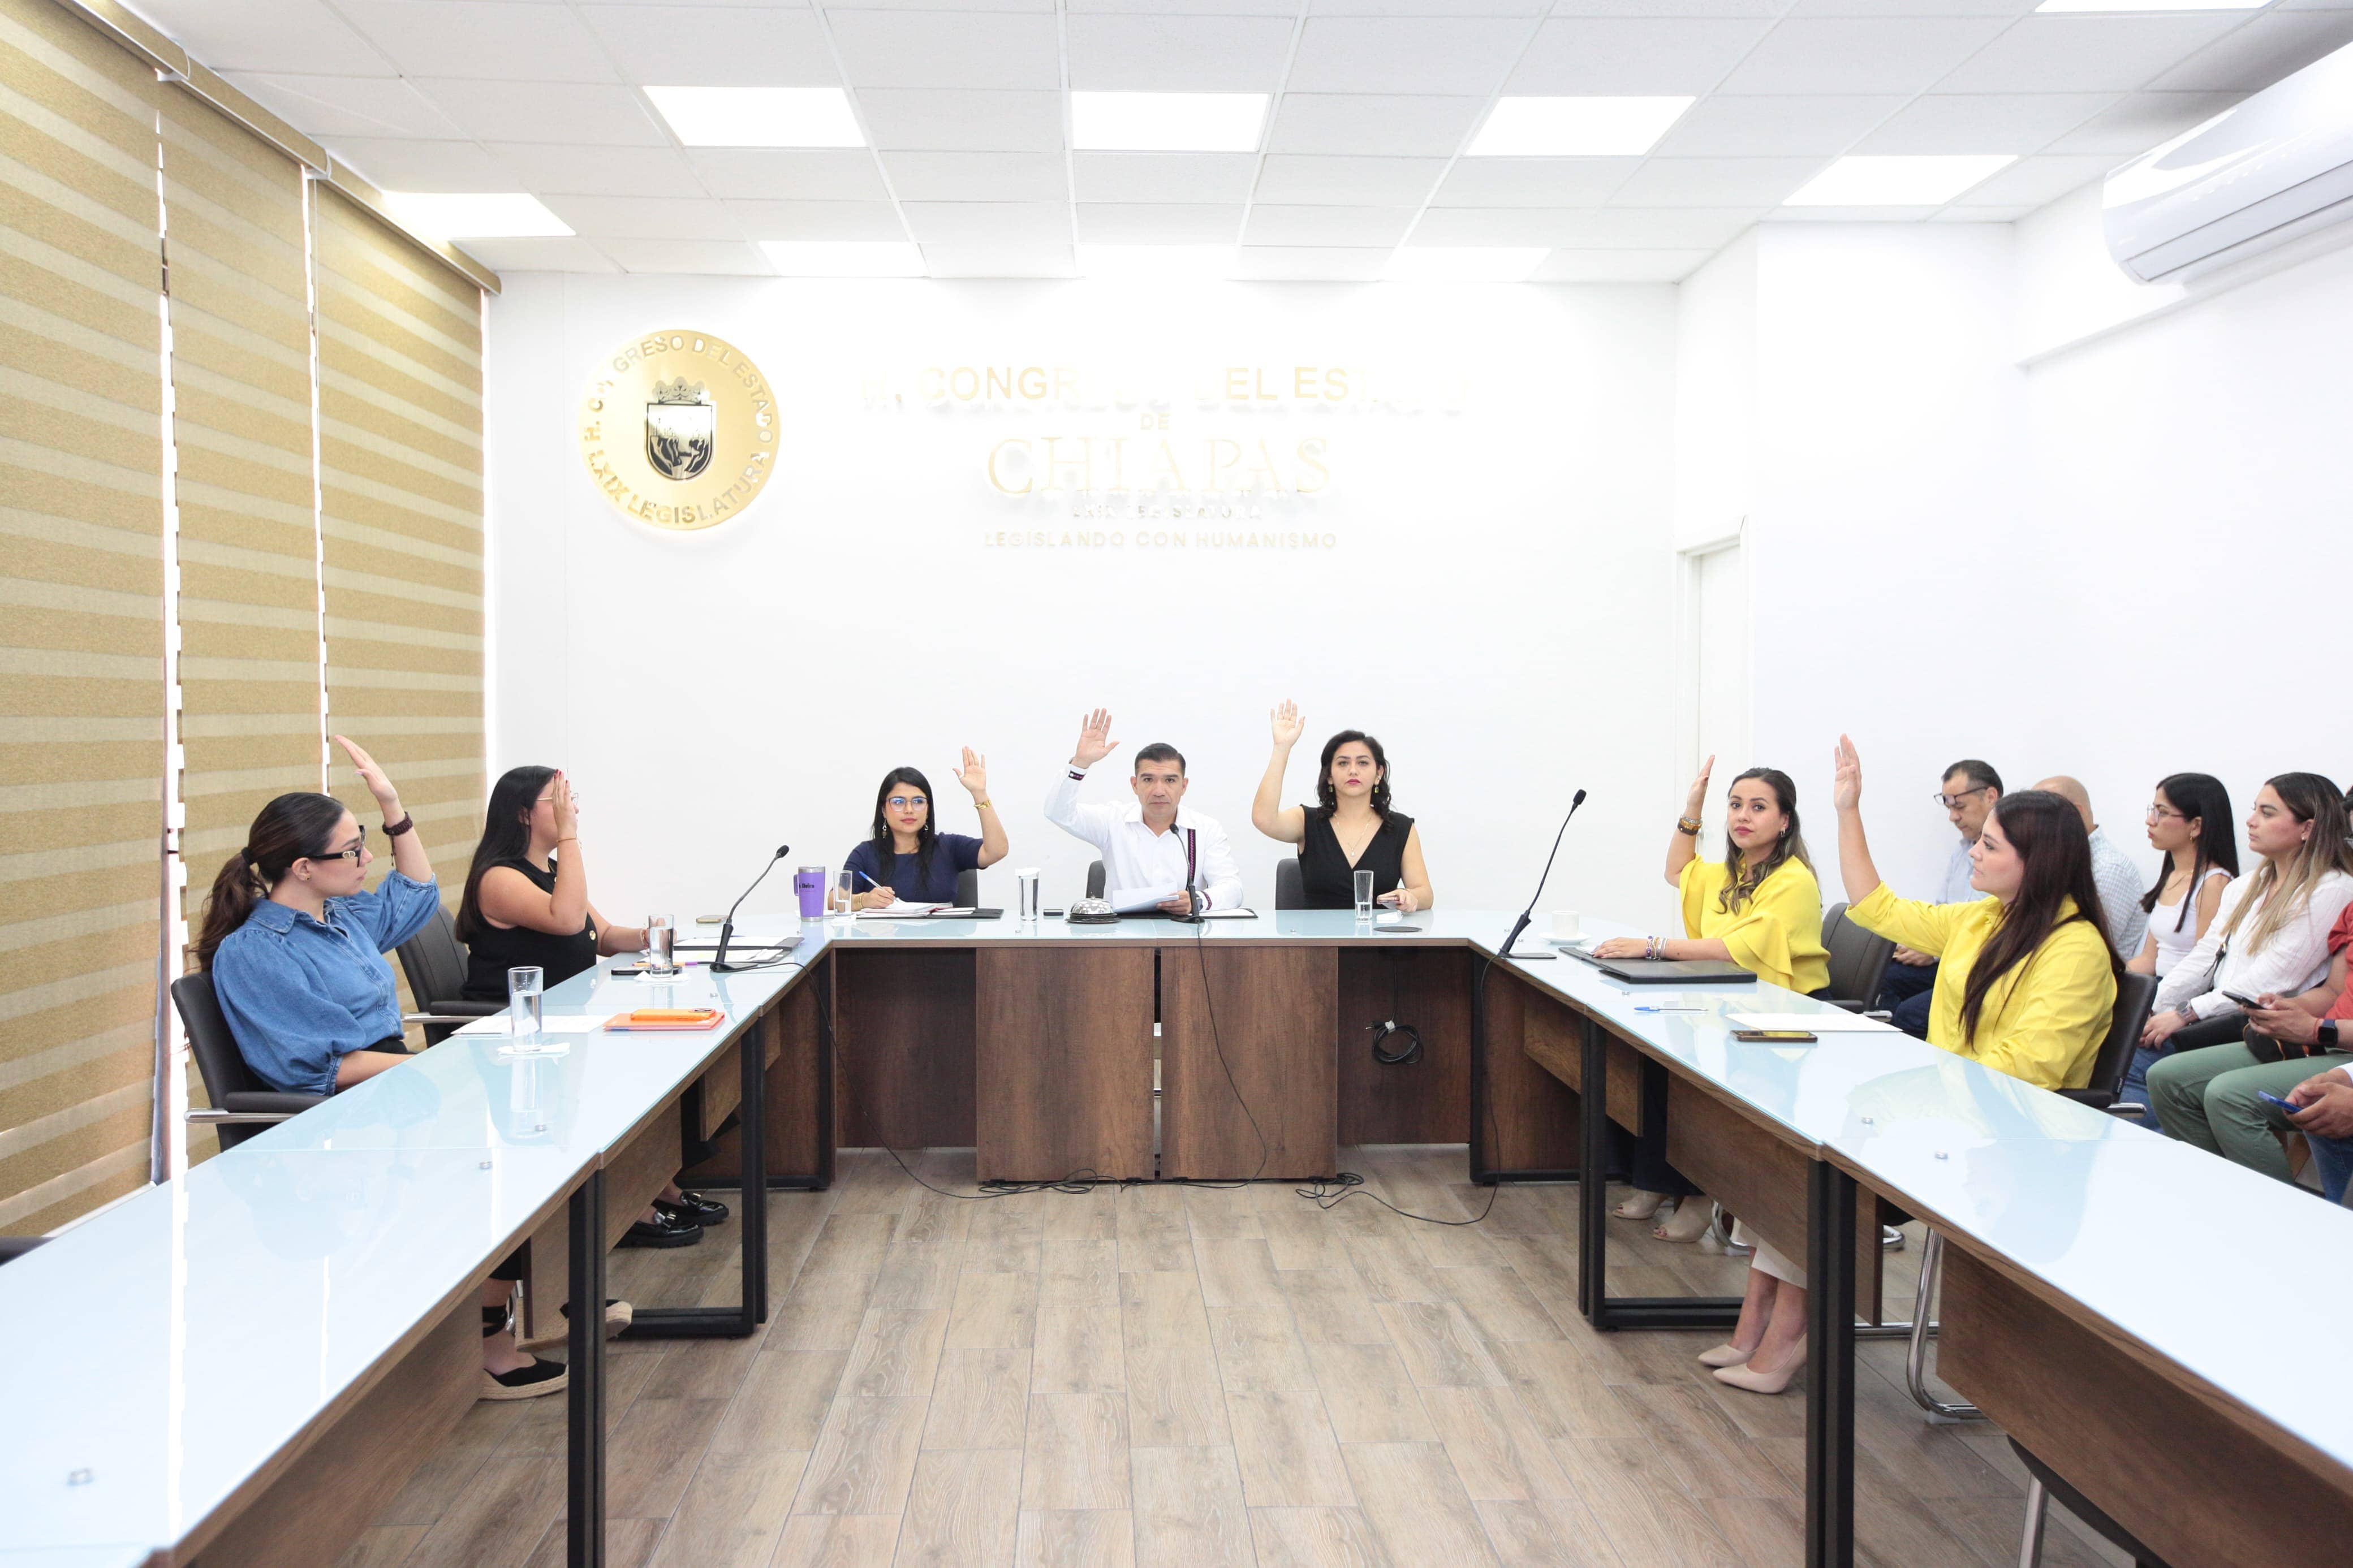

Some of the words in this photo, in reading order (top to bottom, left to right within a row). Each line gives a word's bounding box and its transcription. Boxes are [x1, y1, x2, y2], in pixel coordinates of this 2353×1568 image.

[691, 338, 733, 366] DEL
[732, 361, 774, 444] ESTADO
[1139, 413, 1170, 430] DE
[627, 451, 770, 524] LEGISLATURA
[987, 435, 1331, 495] CHIAPAS
[984, 529, 1126, 548] LEGISLANDO
[1135, 529, 1188, 548] CON
[1195, 529, 1338, 549] HUMANISMO
